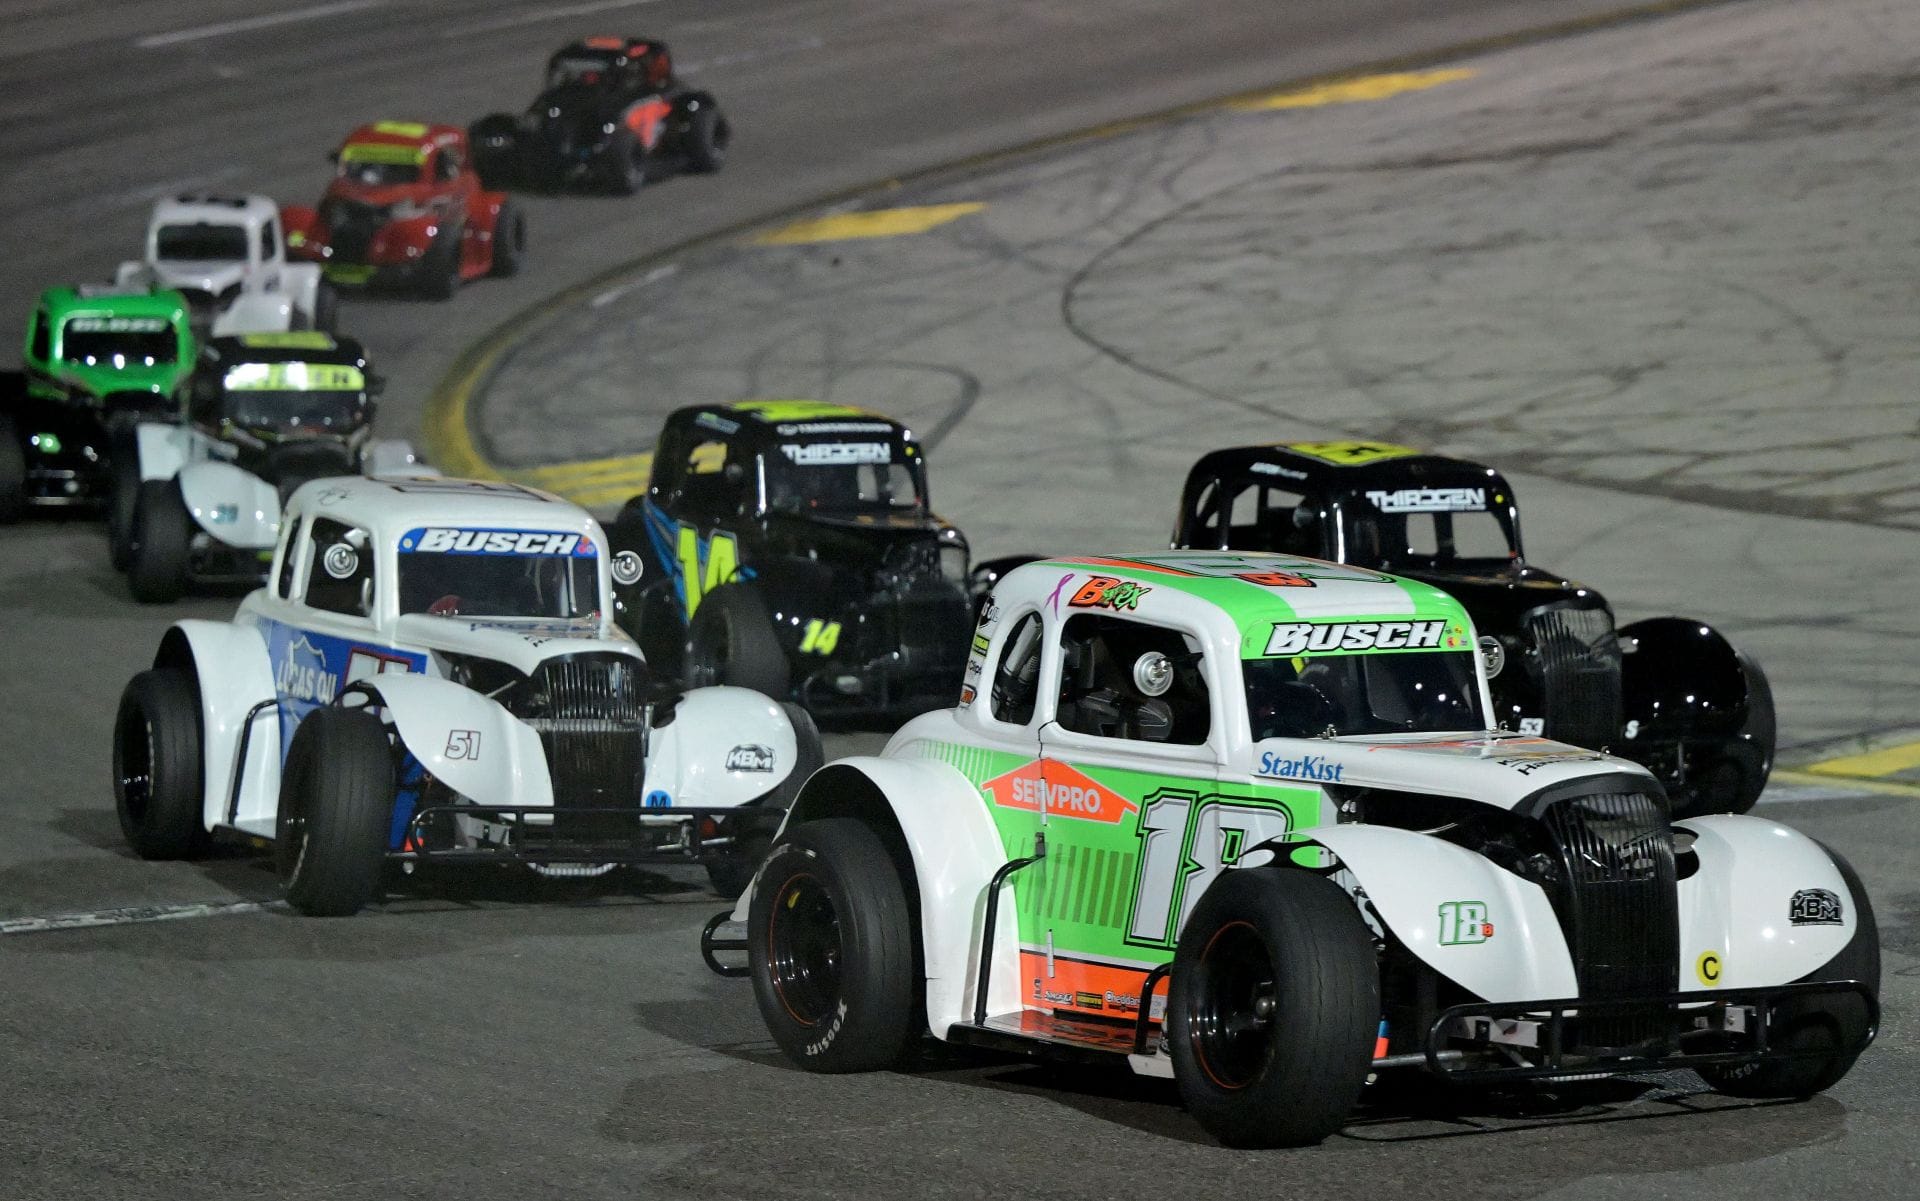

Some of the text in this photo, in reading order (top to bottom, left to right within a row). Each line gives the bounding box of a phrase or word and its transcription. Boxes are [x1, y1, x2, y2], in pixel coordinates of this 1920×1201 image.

[416, 529, 580, 554] BUSCH
[800, 619, 842, 655] 14
[1263, 619, 1448, 656] BUSCH
[445, 730, 481, 760] 51
[726, 749, 773, 768] KBM
[1259, 751, 1343, 782] StarKist
[1788, 895, 1841, 920] KBM
[1703, 956, 1719, 980] C
